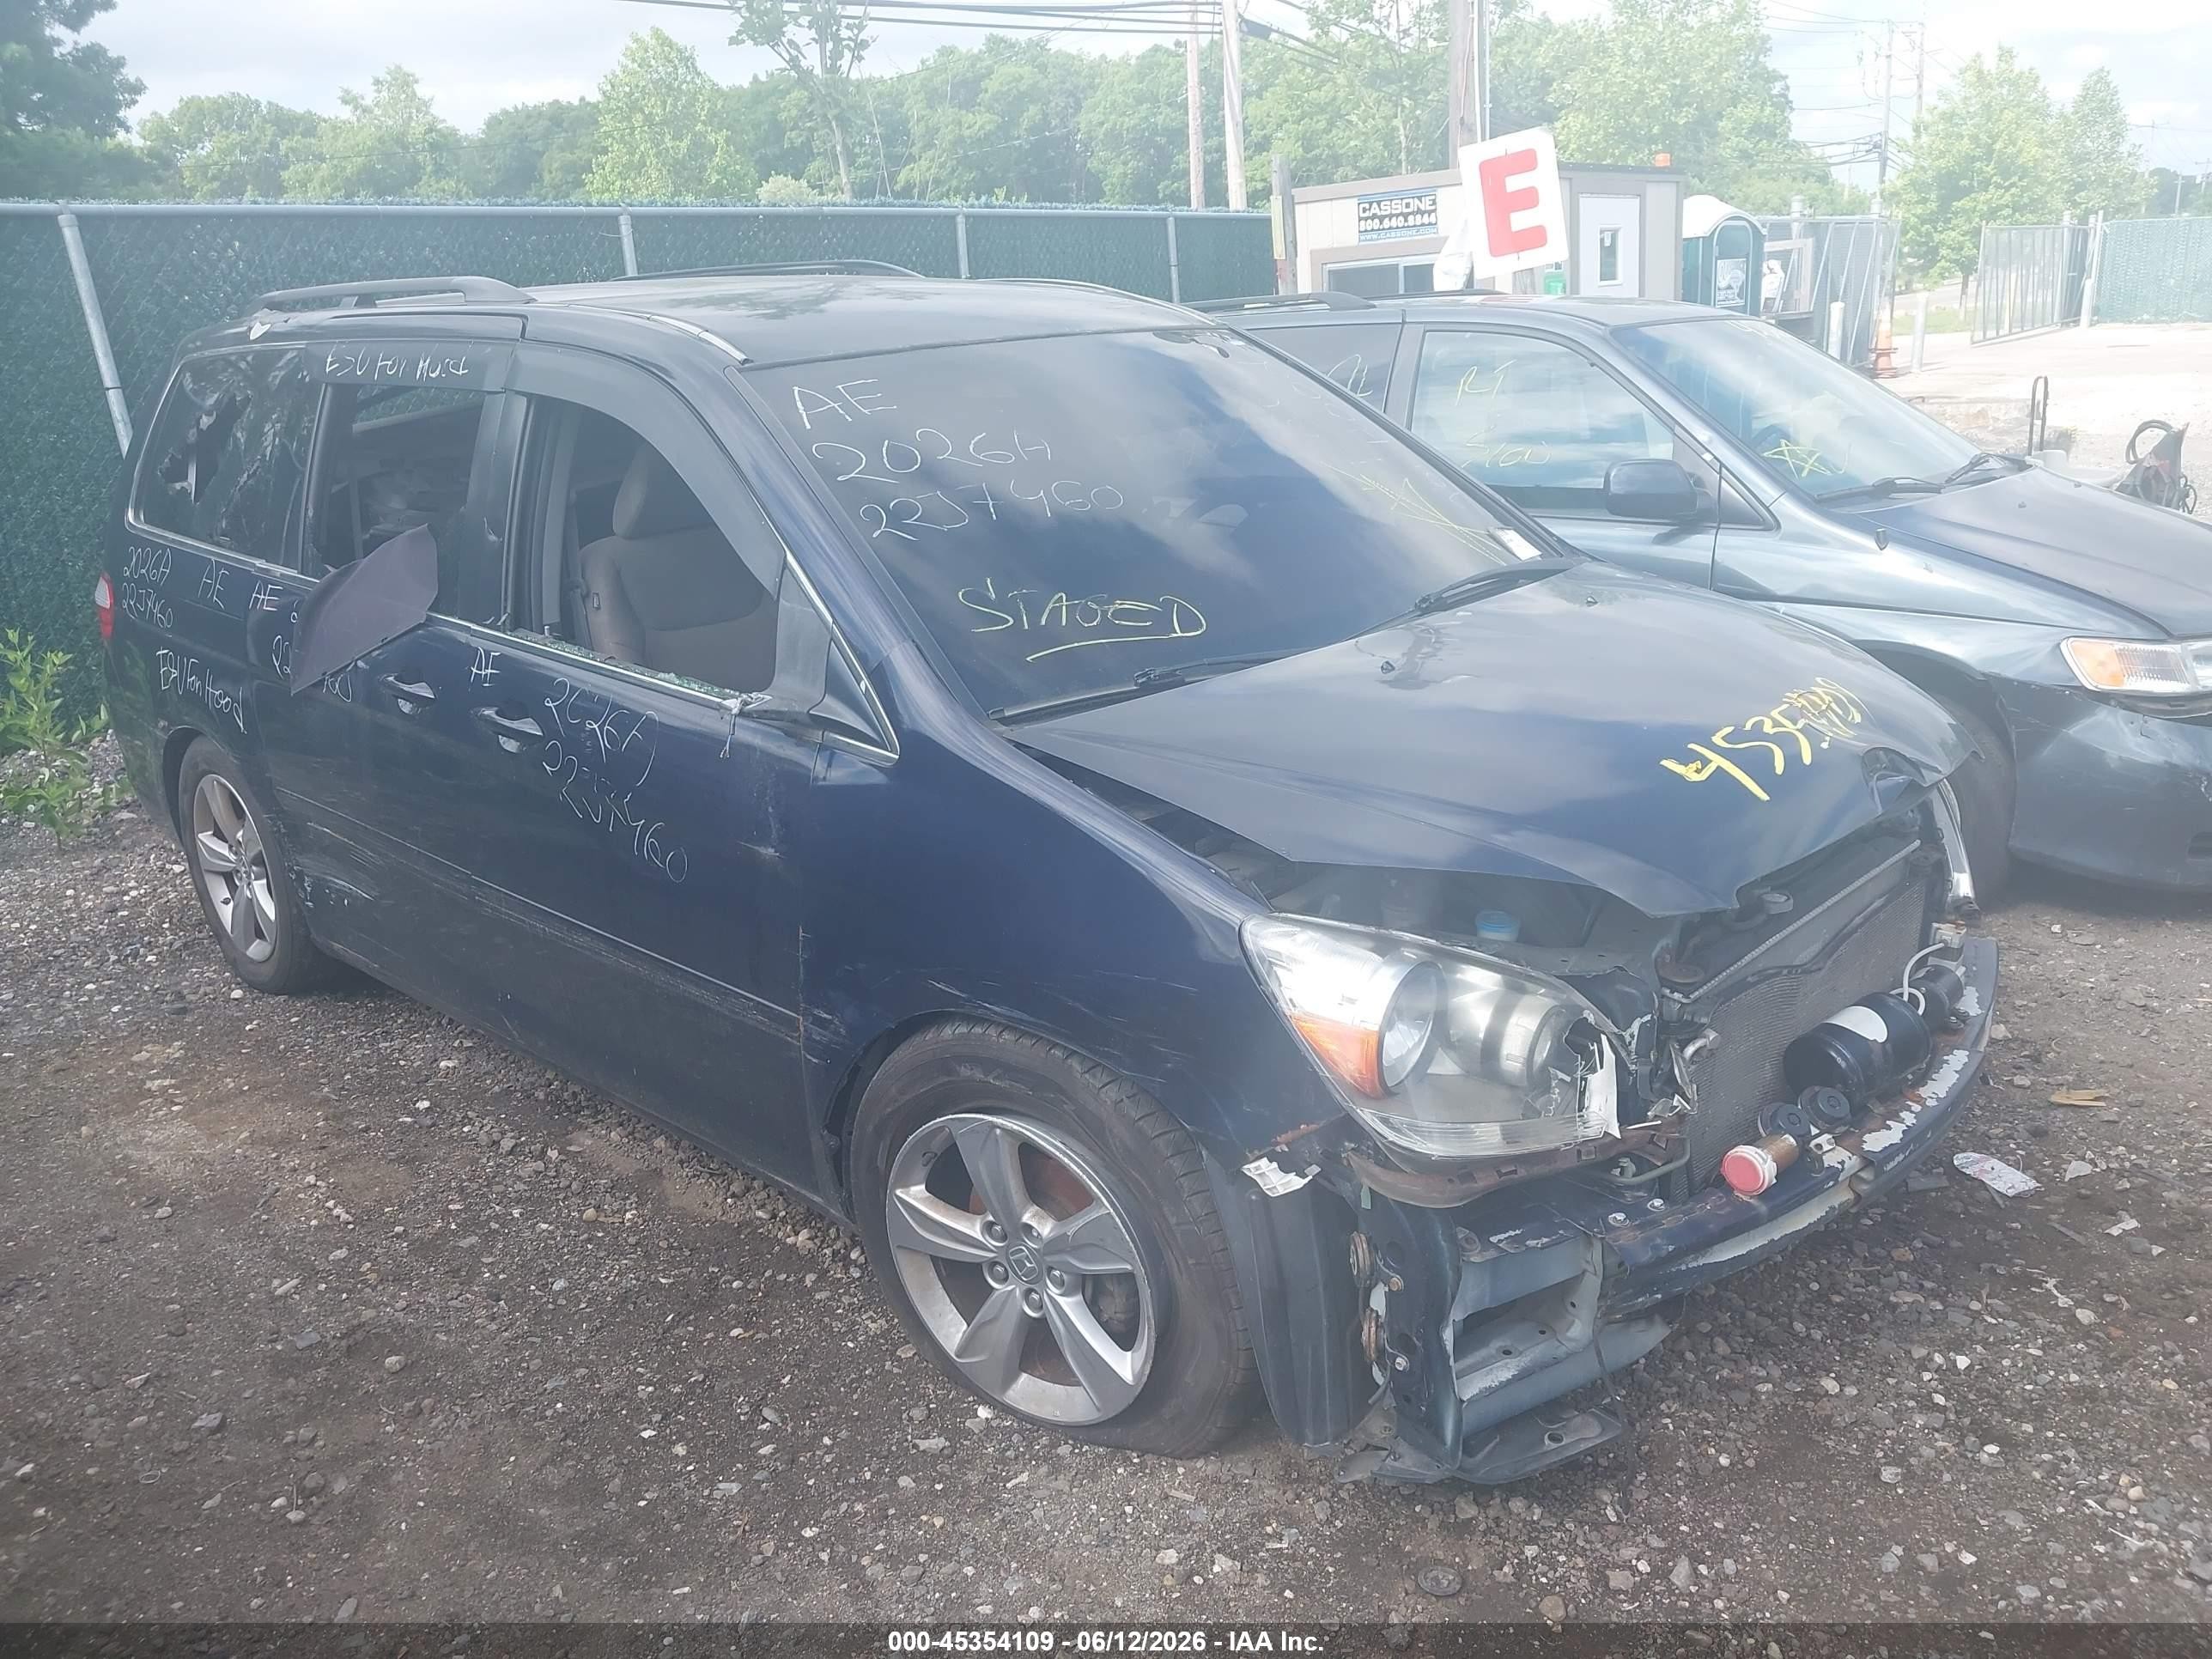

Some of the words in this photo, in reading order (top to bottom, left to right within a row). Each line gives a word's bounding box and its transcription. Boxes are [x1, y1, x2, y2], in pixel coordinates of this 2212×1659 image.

[1359, 195, 1436, 217] CASSONE
[1359, 212, 1437, 232] 800.640.8844
[1479, 149, 1547, 257] E
[793, 379, 897, 429] AE
[198, 558, 229, 610] AE
[249, 580, 283, 611] AE
[957, 577, 1207, 636] STAGED
